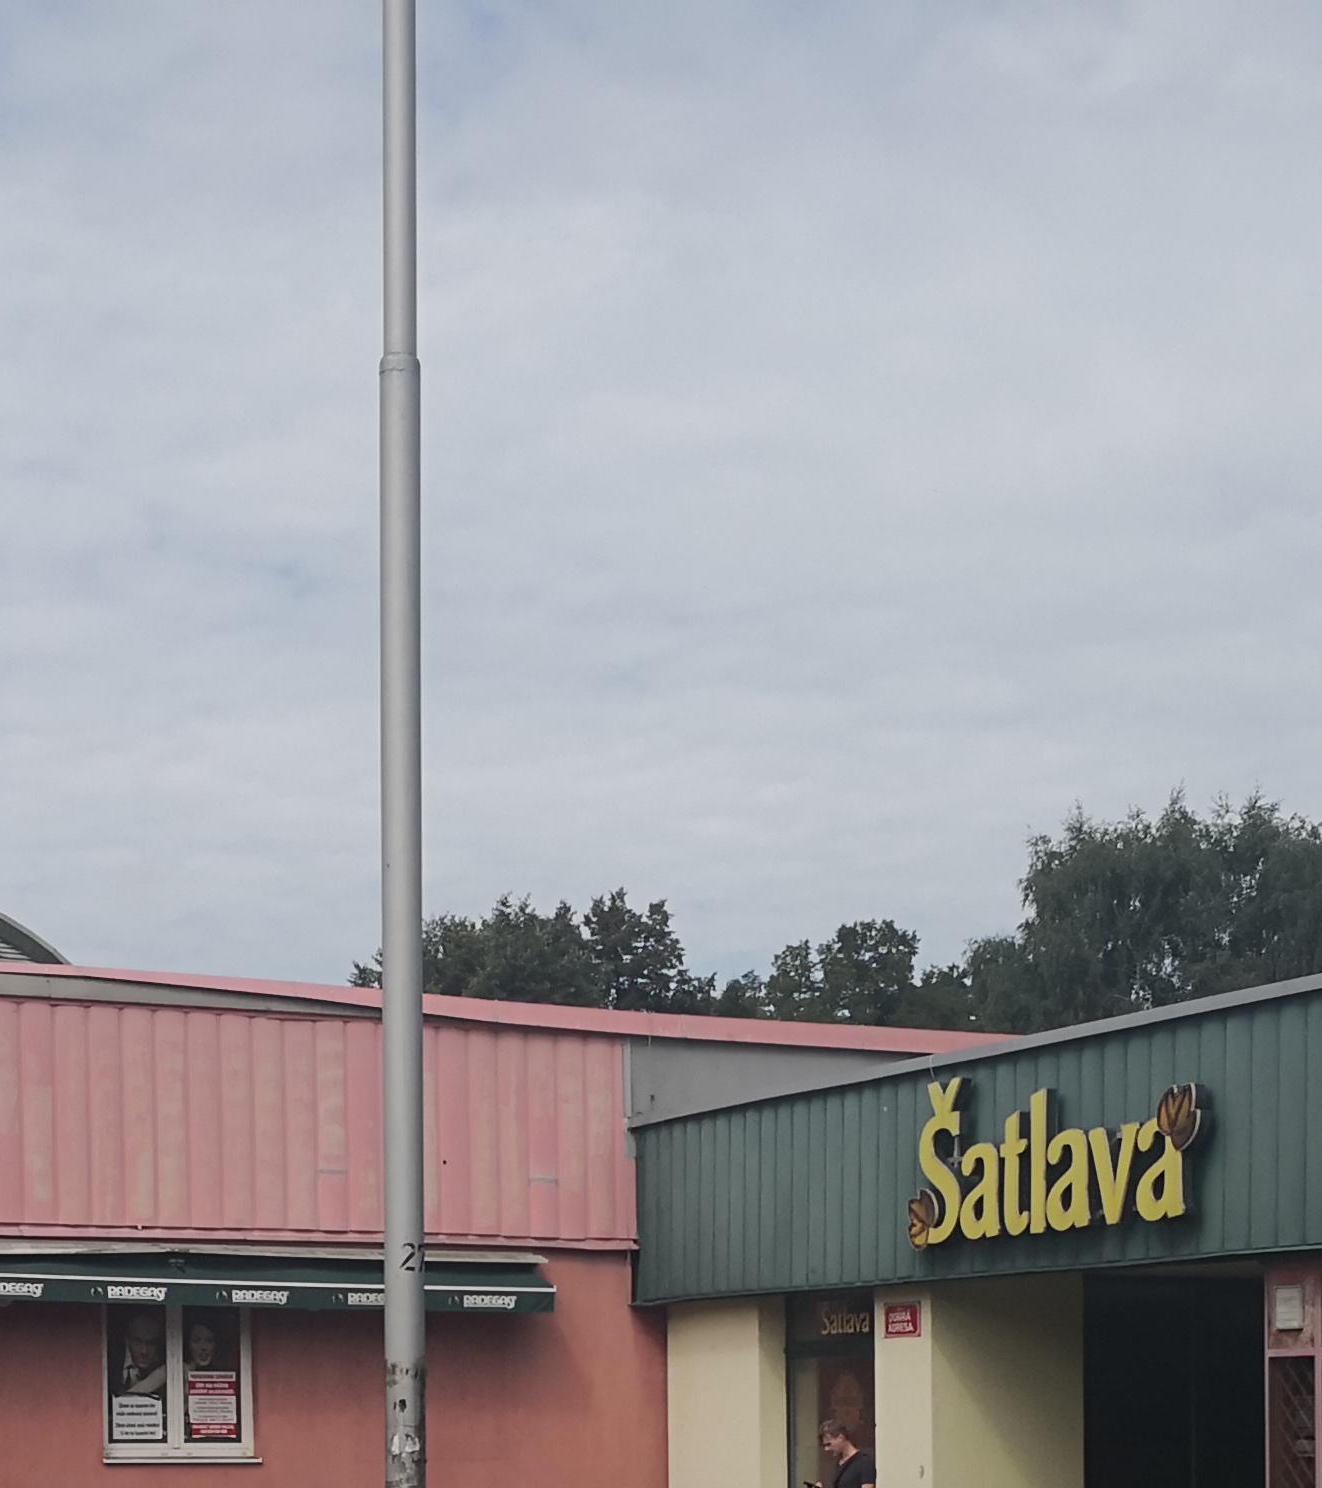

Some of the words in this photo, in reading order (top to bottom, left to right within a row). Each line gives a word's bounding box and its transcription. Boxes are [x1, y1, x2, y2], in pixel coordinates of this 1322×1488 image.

[918, 1077, 1186, 1245] Šatlava
[107, 1285, 168, 1301] RADEGAST
[231, 1290, 290, 1305] RADEGAST
[463, 1294, 517, 1309] RADEGAST
